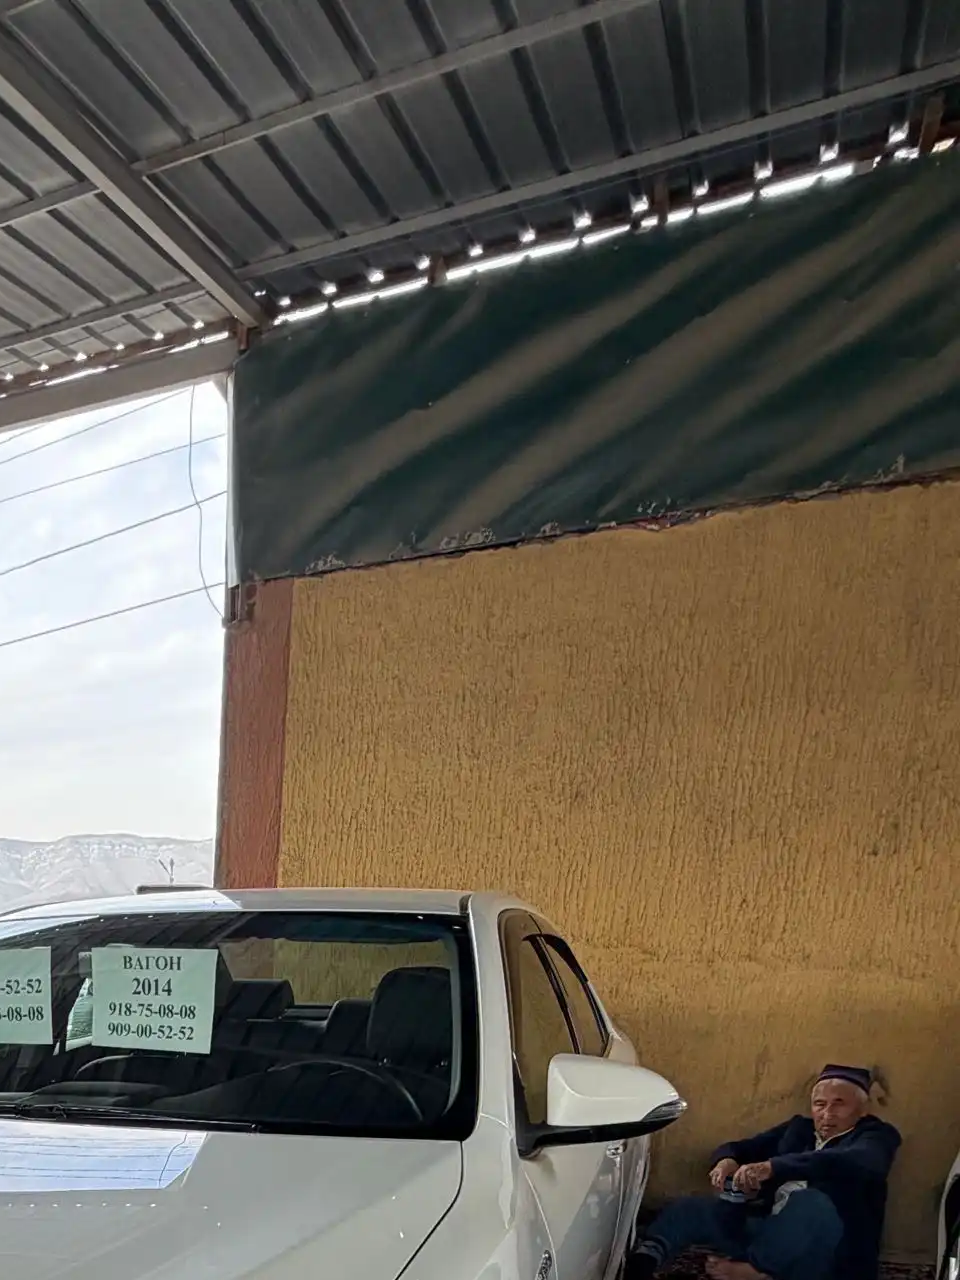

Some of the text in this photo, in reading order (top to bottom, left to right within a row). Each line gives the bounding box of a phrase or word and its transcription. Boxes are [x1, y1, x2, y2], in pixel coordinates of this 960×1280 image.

[123, 955, 182, 971] ВАГОН
[132, 977, 172, 997] 2014
[109, 1002, 197, 1020] 918-75-08-08
[107, 1022, 195, 1041] 909-00-52-52
